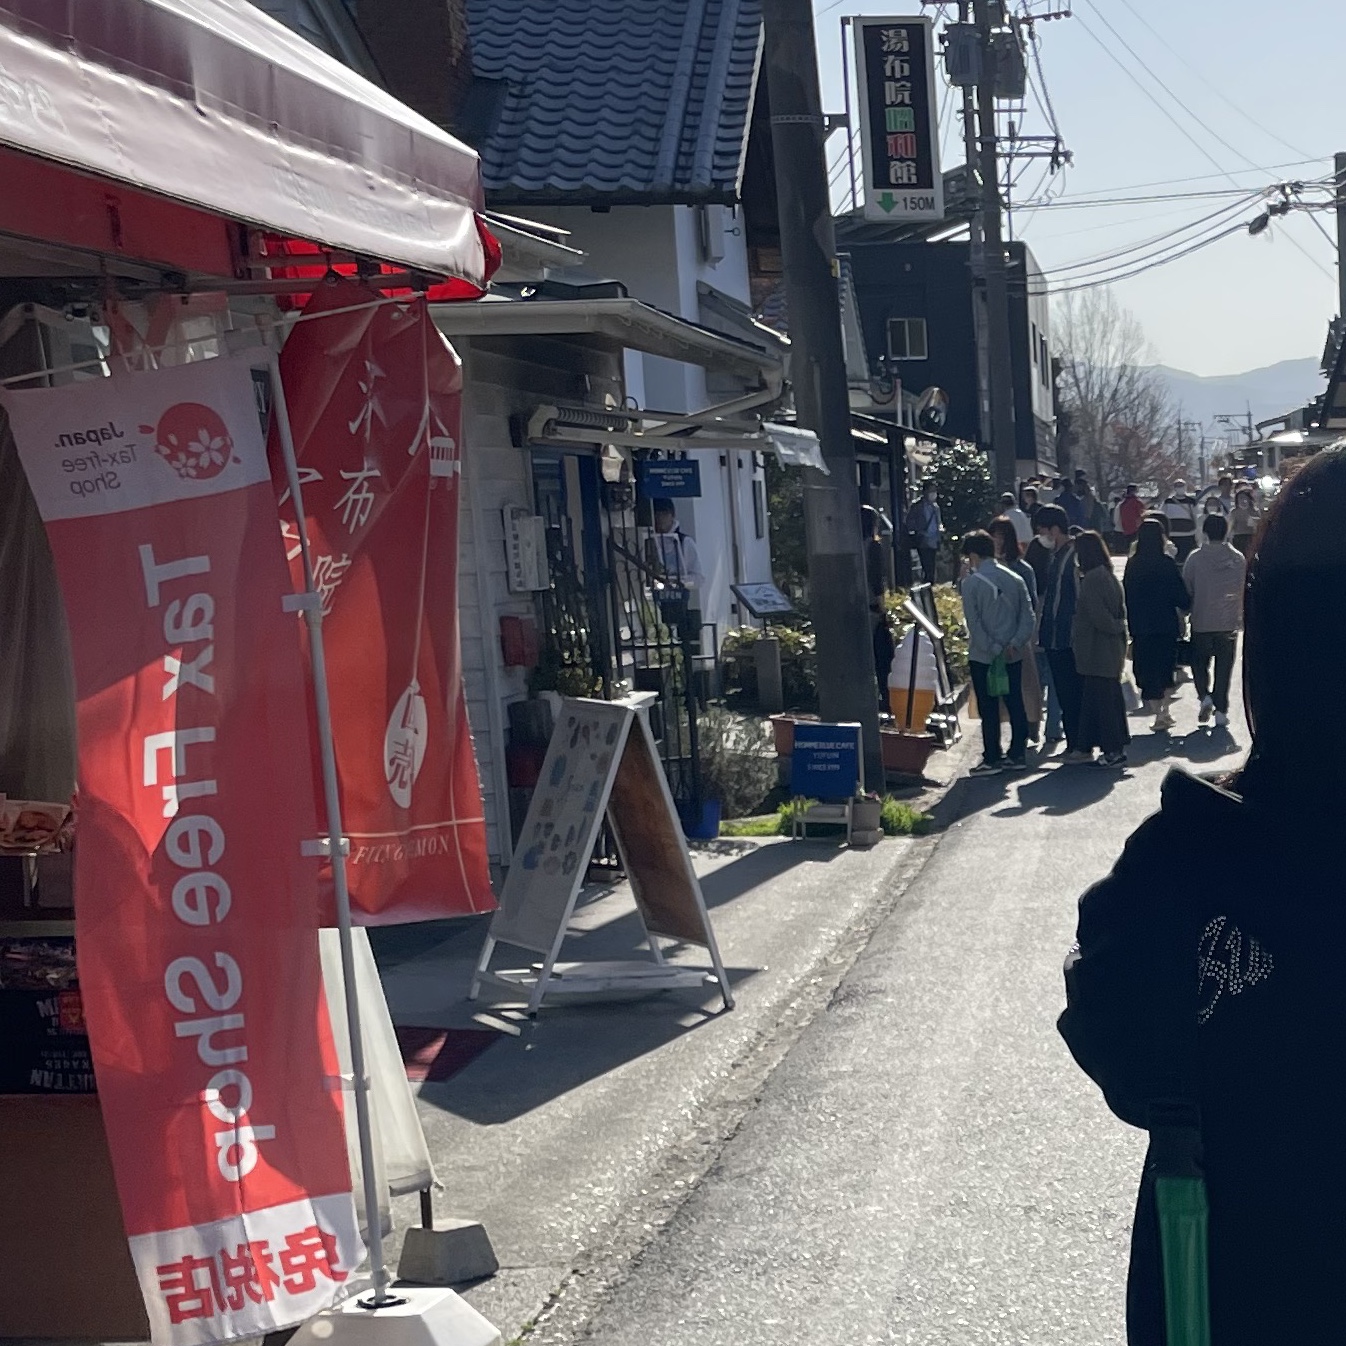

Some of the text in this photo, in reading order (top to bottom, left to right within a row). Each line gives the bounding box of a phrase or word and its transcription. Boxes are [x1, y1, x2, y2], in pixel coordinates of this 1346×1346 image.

[880, 28, 918, 185] 湯布院昭和館
[902, 196, 936, 211] 150M
